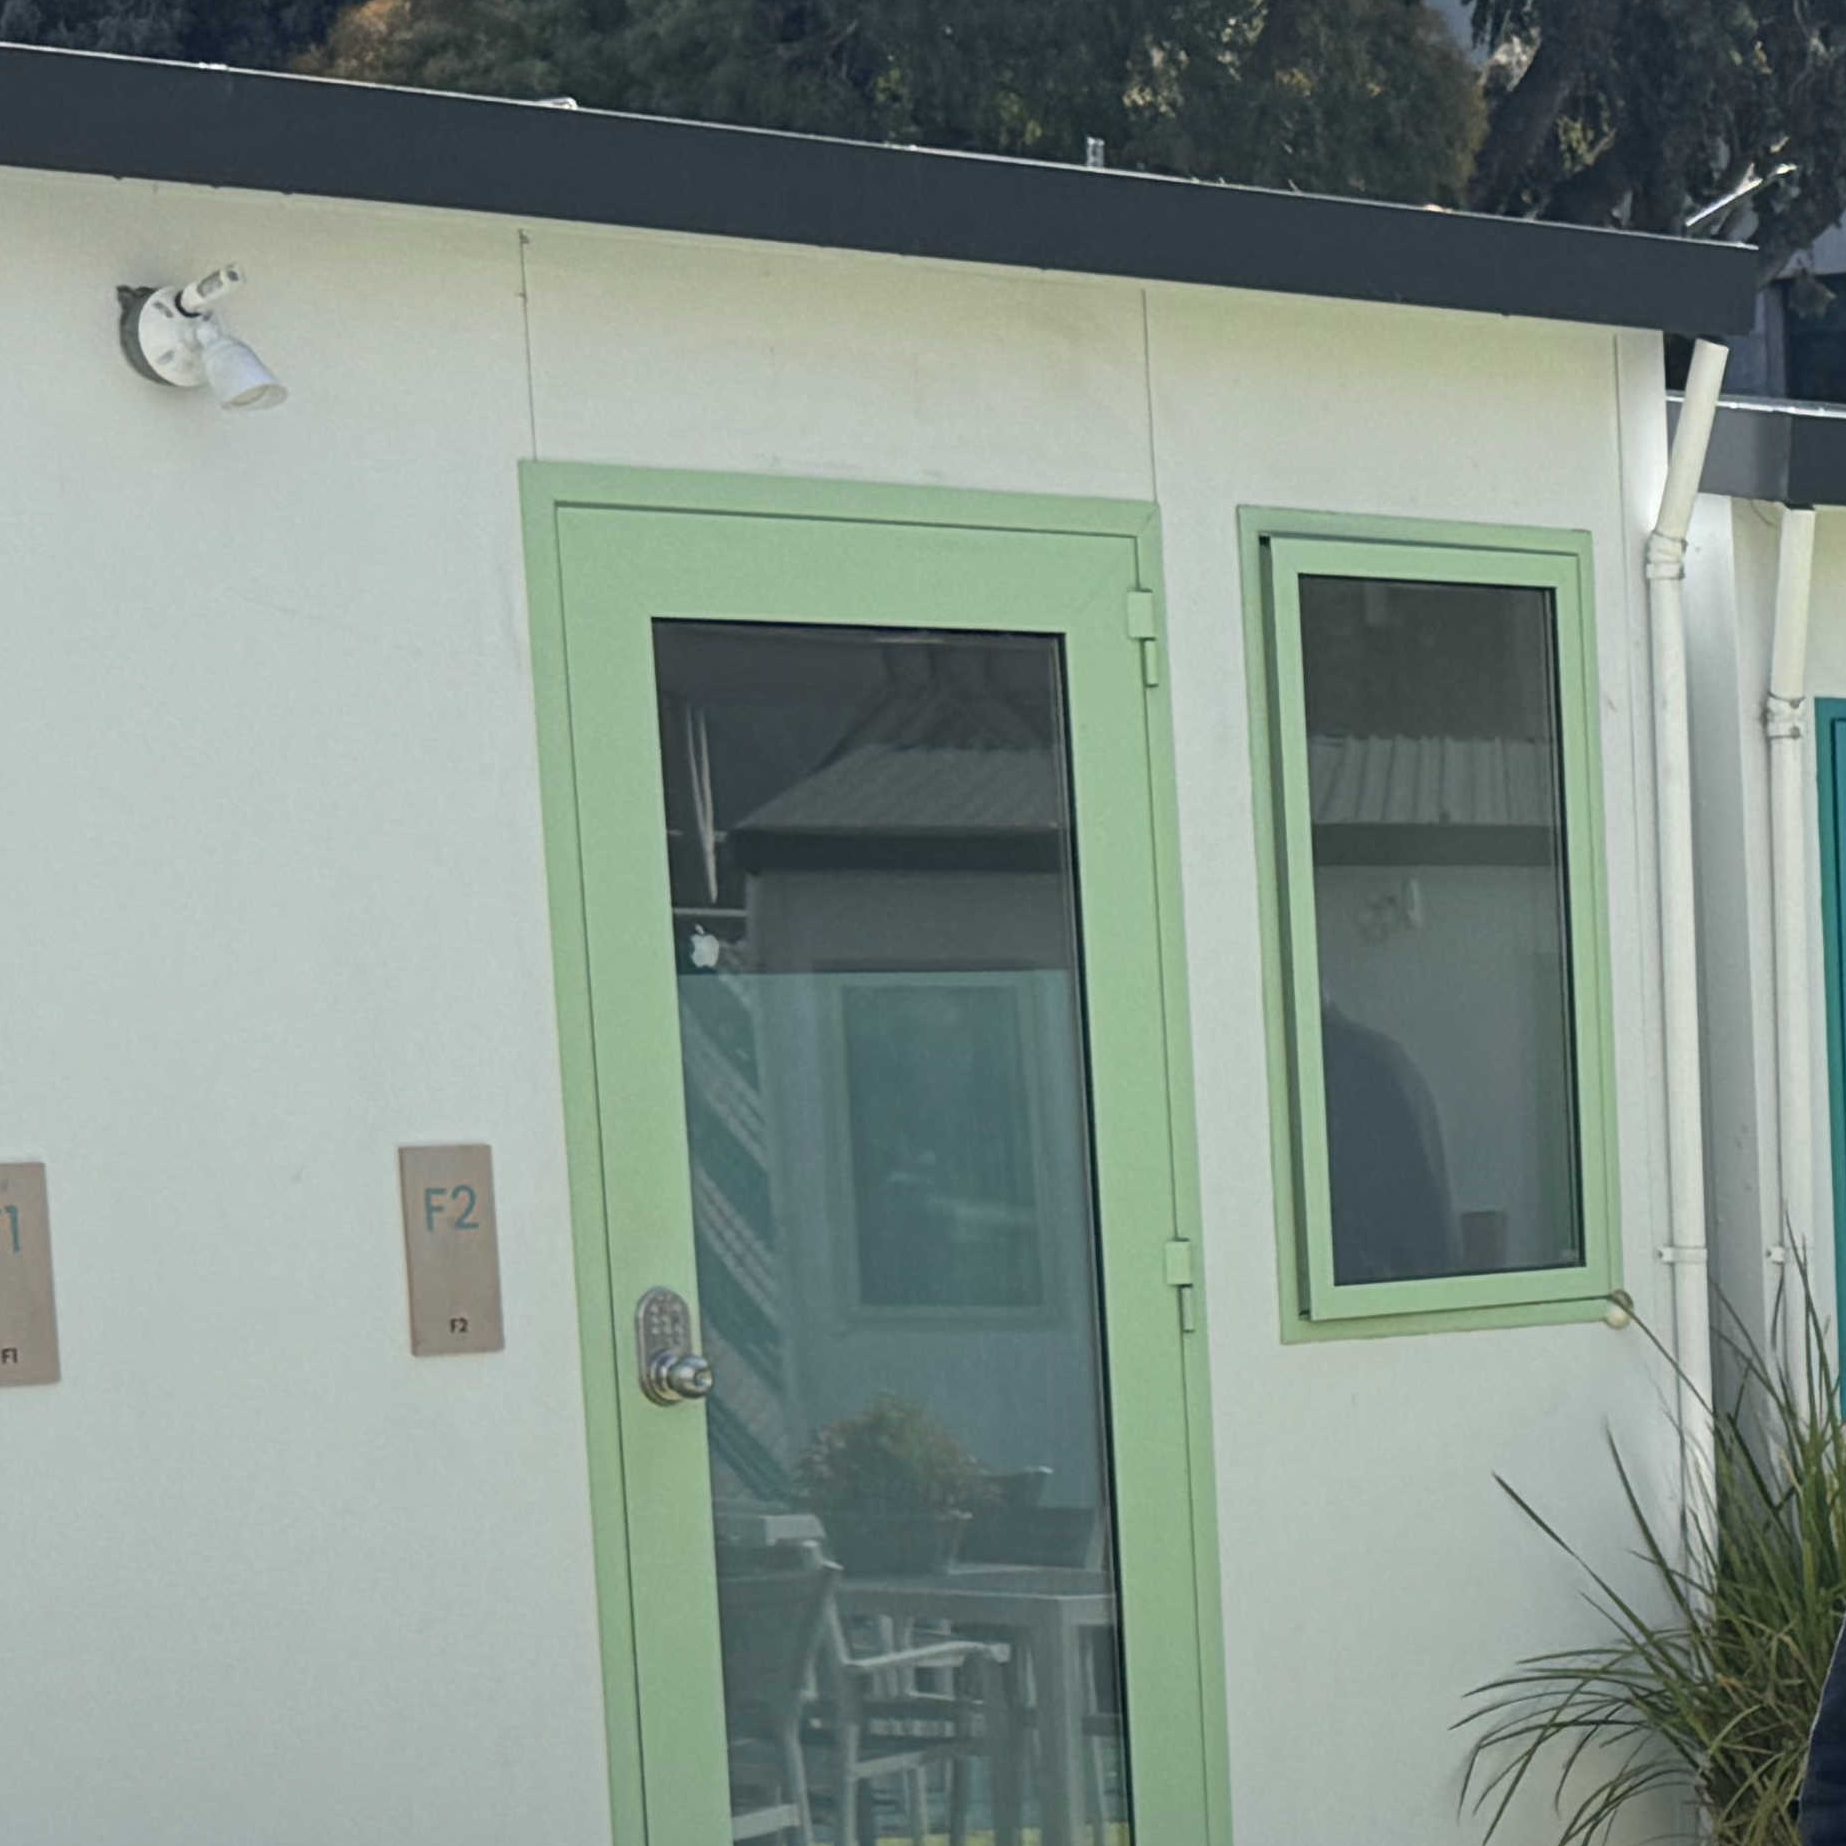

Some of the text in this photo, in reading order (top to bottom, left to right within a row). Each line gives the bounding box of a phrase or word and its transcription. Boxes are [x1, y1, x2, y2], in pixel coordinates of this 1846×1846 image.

[0, 1204, 20, 1253] 1
[424, 1185, 480, 1232] F2
[450, 1317, 469, 1334] F2
